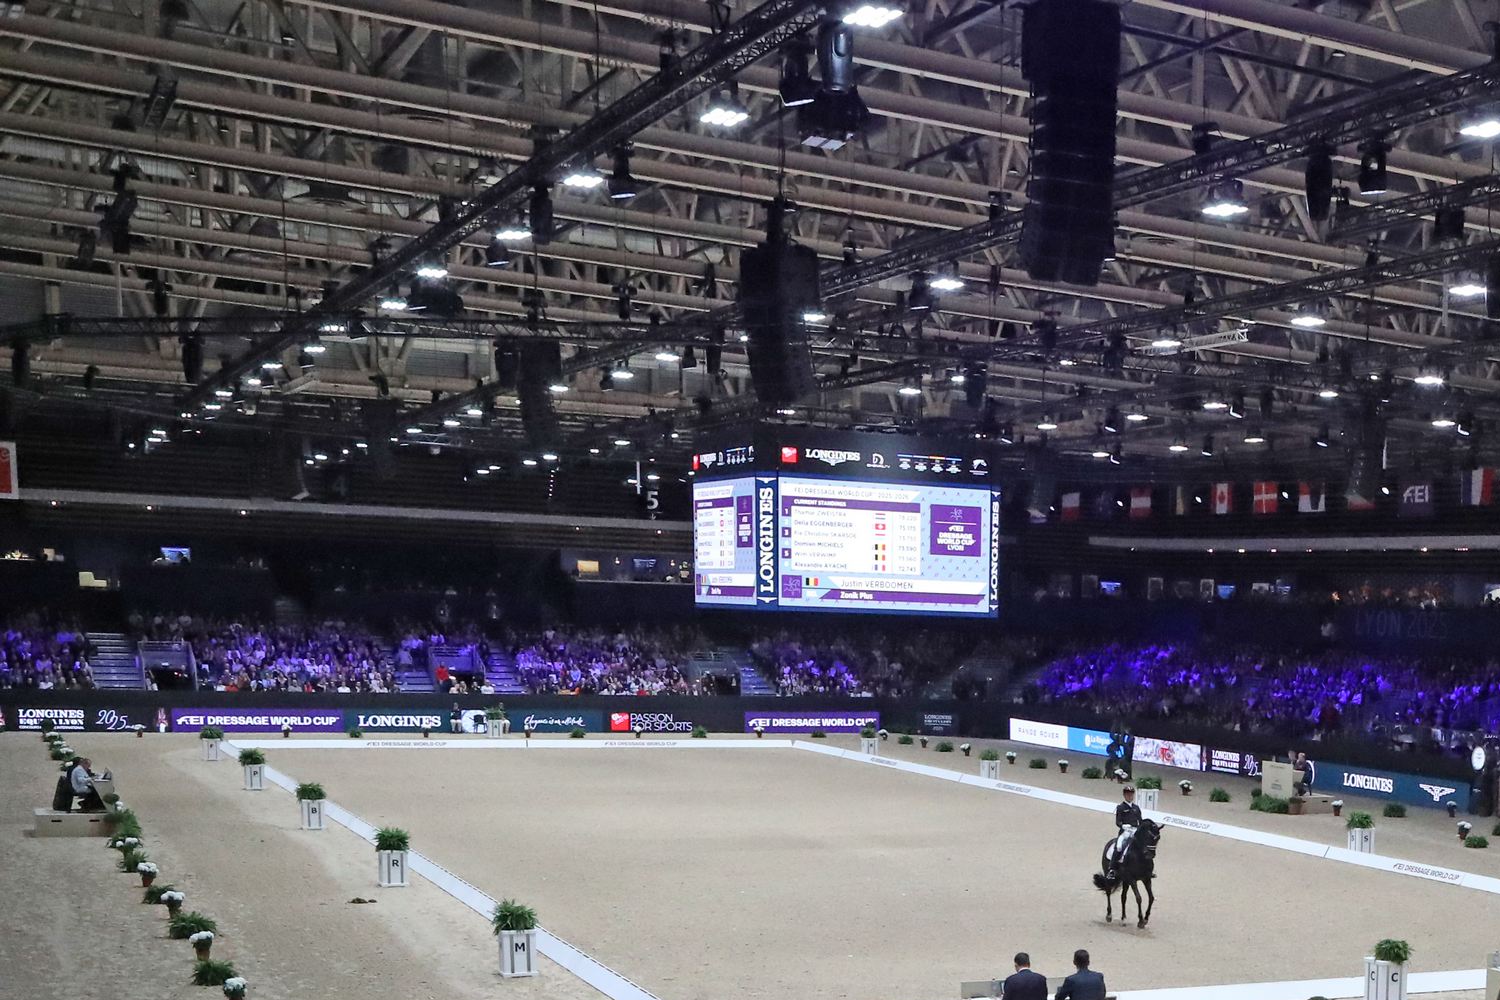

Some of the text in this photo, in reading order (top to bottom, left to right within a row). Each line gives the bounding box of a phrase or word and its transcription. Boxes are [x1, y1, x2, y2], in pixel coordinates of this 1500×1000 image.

[805, 449, 860, 461] LONGINES
[1403, 485, 1429, 503] FEI
[647, 491, 659, 510] 5
[760, 487, 774, 592] LONGINES
[991, 502, 1000, 600] LONGINES
[841, 580, 914, 590] Justin VERBOOMEN
[840, 591, 858, 599] Zonik
[18, 709, 84, 718] LONGINES
[630, 712, 673, 722] PASSION
[207, 715, 269, 726] DRESSAGE
[270, 716, 313, 726] WORLD
[313, 716, 337, 726] CUP
[358, 715, 441, 727] LONGINES
[630, 721, 693, 731] FOR SPORTS
[772, 718, 821, 727] DRESSAGE
[822, 718, 855, 727] WORLD
[1018, 726, 1060, 740] RANGE ROVER
[1211, 749, 1239, 761] LONGINES
[1343, 772, 1393, 794] LONGINES
[1405, 865, 1431, 874] DRESSAGE
[1430, 869, 1448, 879] WORLD
[515, 942, 525, 952] M
[1370, 971, 1376, 981] C
[1391, 972, 1399, 983] C
